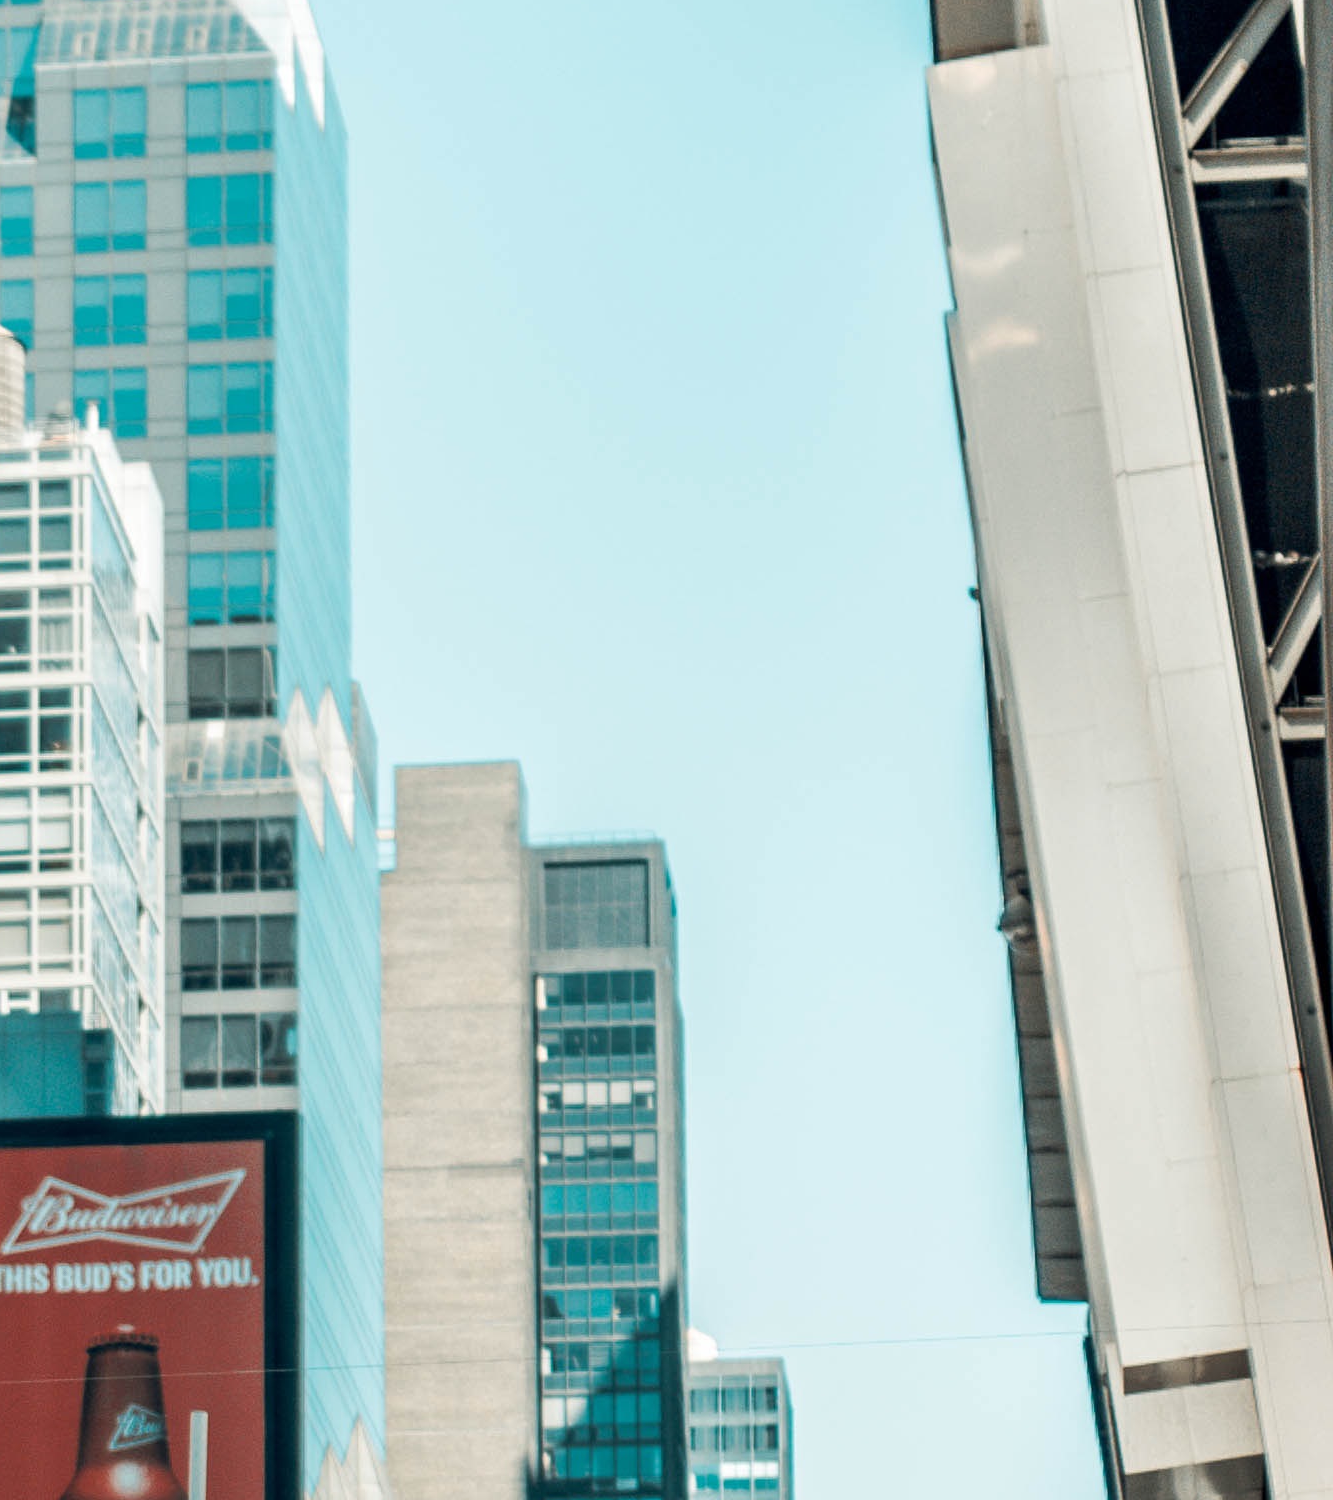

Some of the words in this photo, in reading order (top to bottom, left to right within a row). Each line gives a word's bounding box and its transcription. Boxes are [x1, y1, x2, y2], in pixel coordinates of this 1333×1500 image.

[21, 1196, 222, 1234] Budweiser
[53, 1261, 135, 1293] BUD'S
[139, 1260, 193, 1289] FOR
[198, 1257, 261, 1287] YOU.
